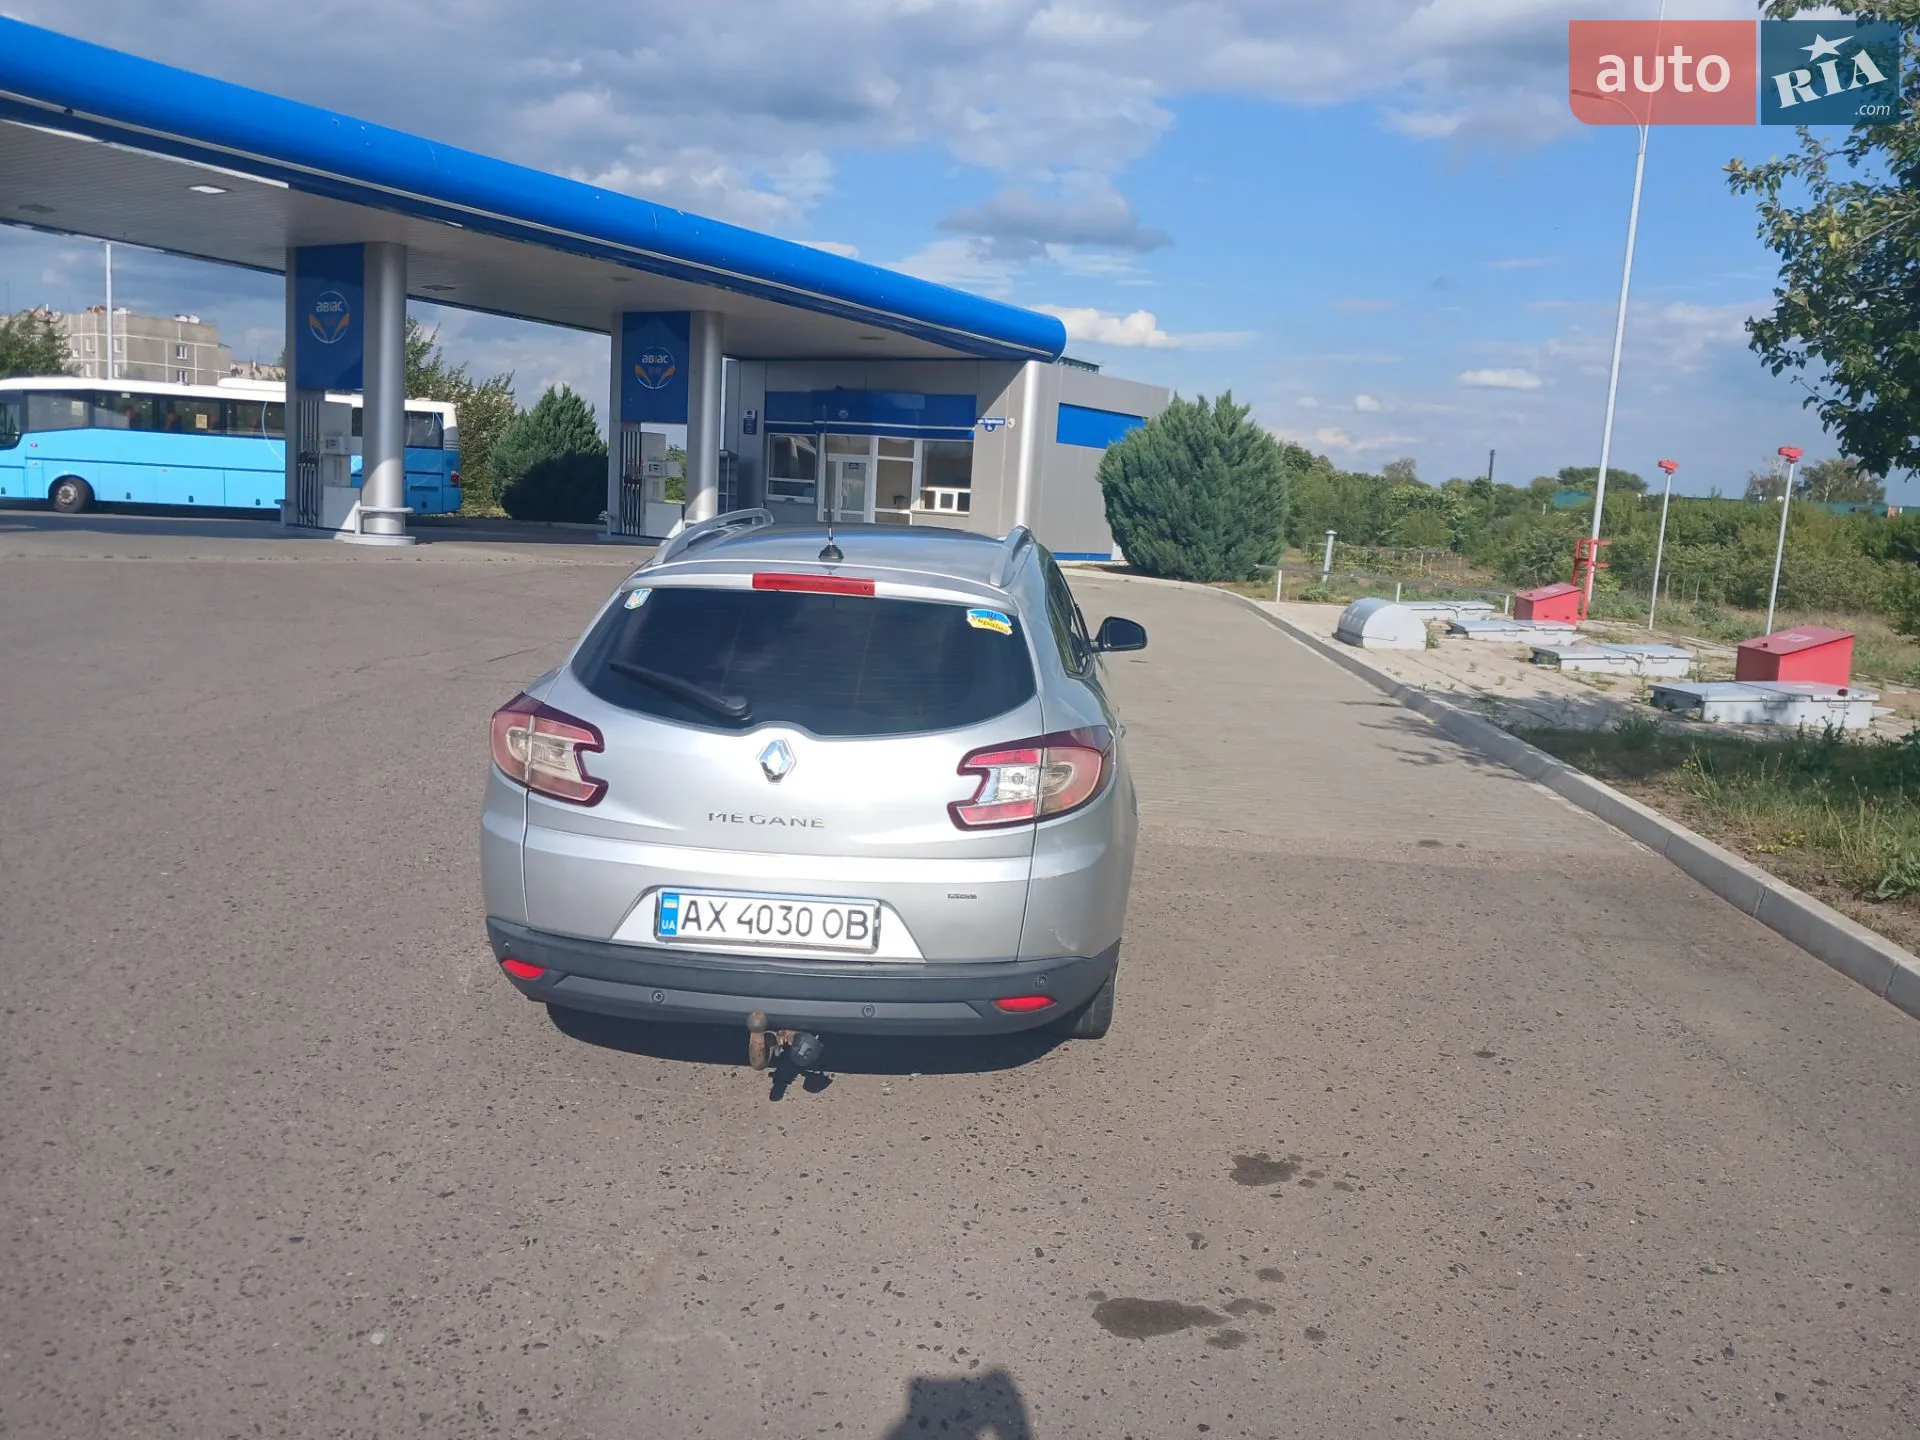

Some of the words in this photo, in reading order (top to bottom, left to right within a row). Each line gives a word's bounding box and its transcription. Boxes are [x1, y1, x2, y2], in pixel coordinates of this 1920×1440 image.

[708, 812, 825, 828] MEGANE
[661, 919, 676, 930] UA
[681, 900, 728, 933] AX
[737, 903, 813, 938] 4030
[822, 908, 869, 941] OB
